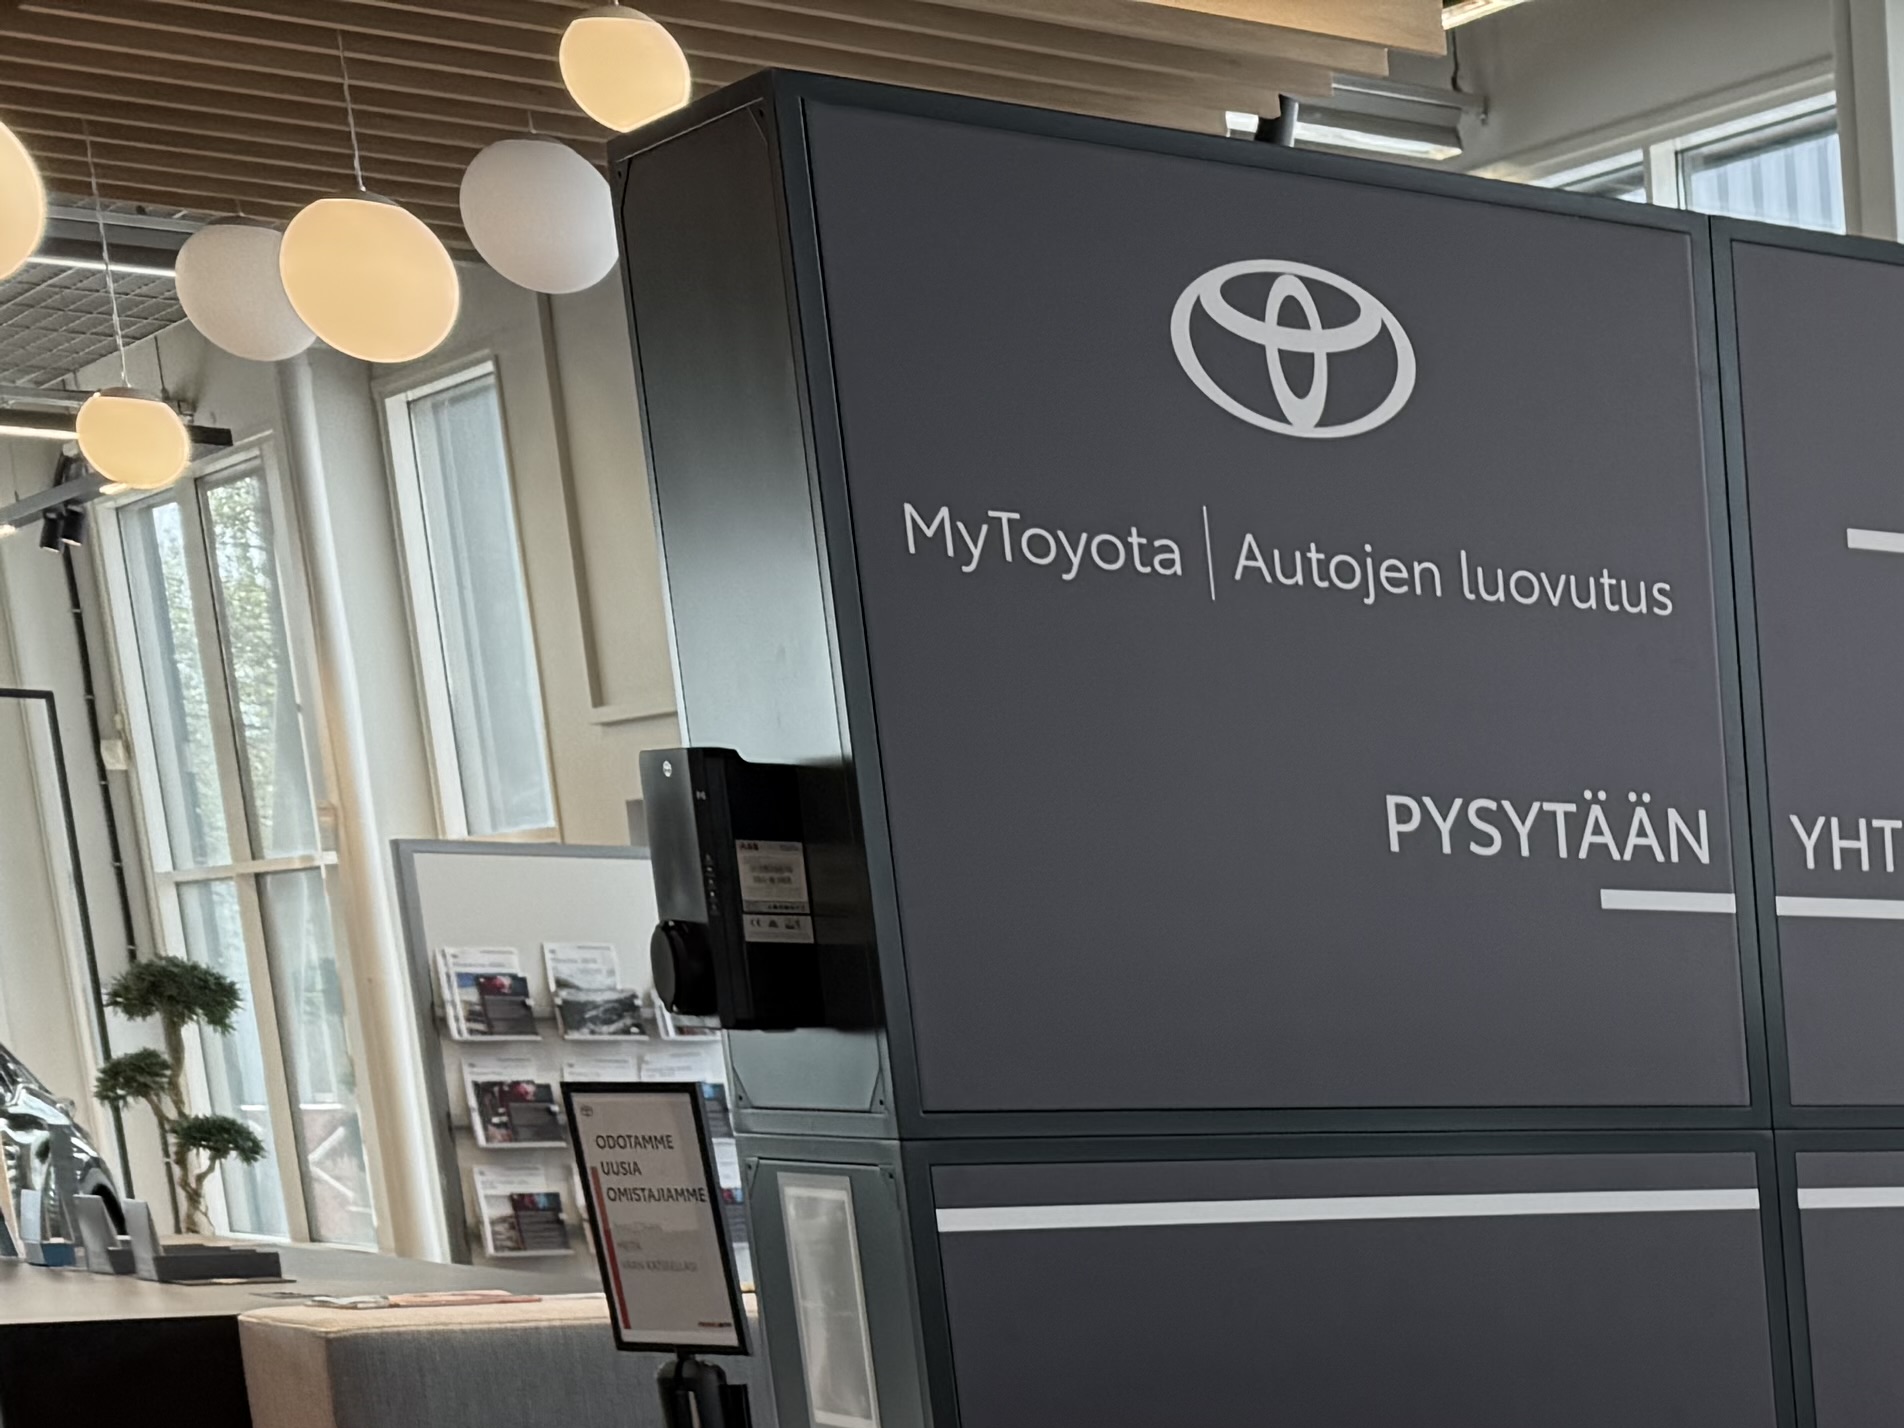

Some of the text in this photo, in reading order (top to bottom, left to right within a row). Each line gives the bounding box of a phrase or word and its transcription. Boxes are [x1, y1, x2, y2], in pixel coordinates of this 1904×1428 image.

[902, 502, 1674, 617] MyToyota Autojen luovutus
[1385, 789, 1711, 866] PYSYTÄÄN
[595, 1134, 675, 1150] ODOTAMME
[600, 1161, 643, 1177] UUSIA
[605, 1186, 709, 1203] OMISTAJIAMME
